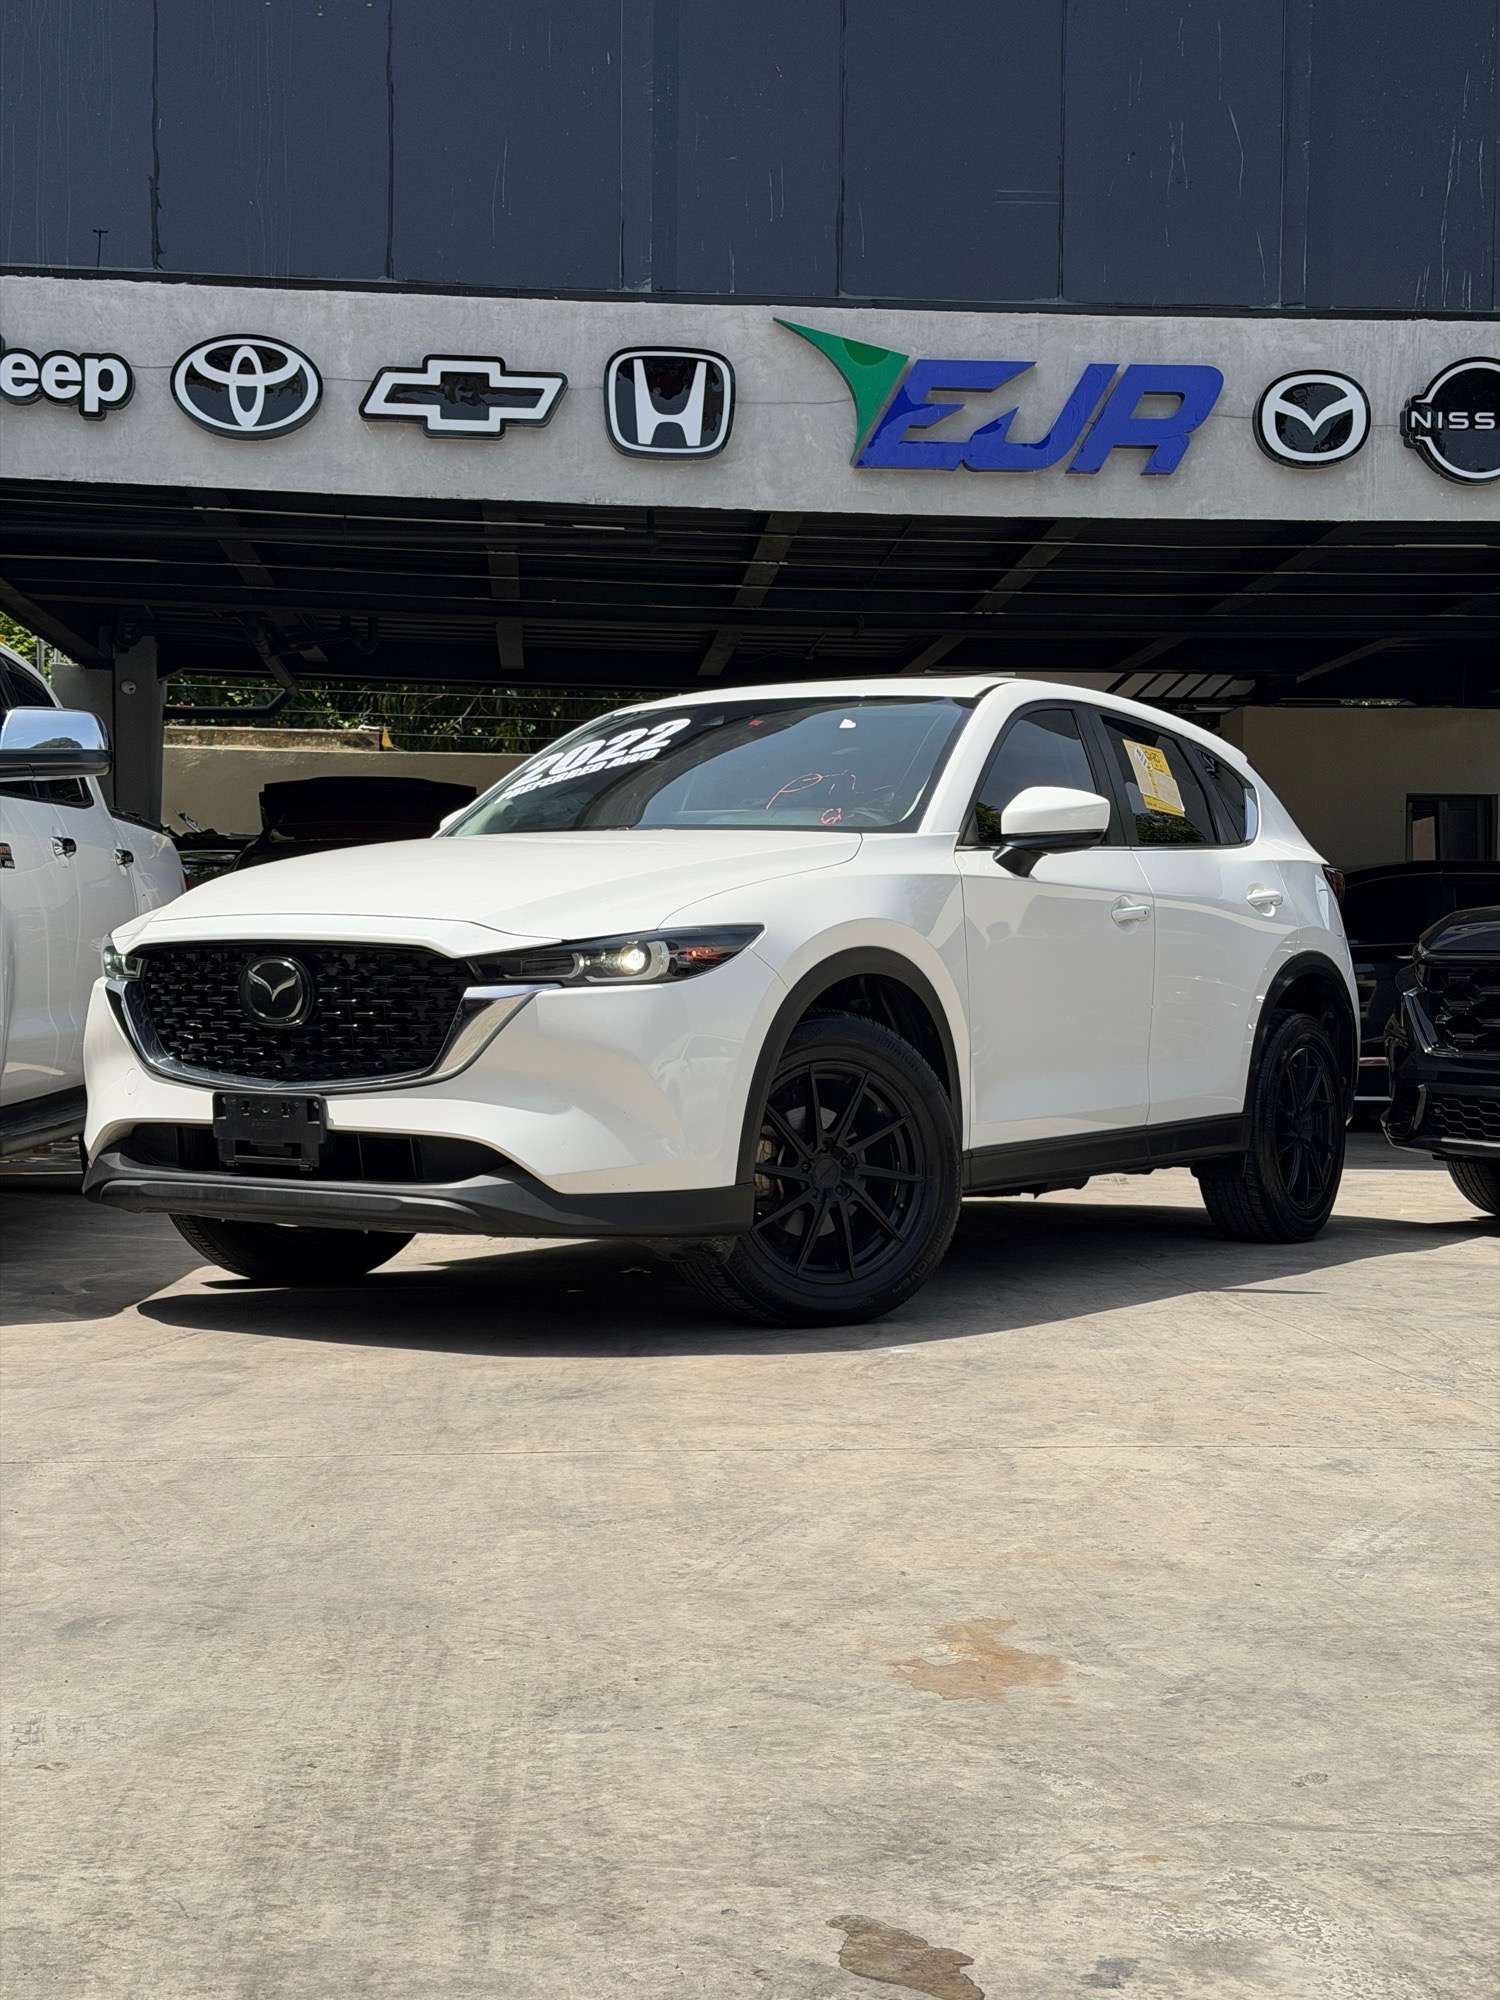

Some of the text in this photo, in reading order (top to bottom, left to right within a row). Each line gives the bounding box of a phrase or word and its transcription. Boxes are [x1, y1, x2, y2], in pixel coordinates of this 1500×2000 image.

[0, 353, 128, 412] eep
[852, 358, 1224, 477] EJR
[1410, 410, 1500, 430] NISS
[504, 718, 692, 793] 2022
[605, 748, 661, 770] AWD
